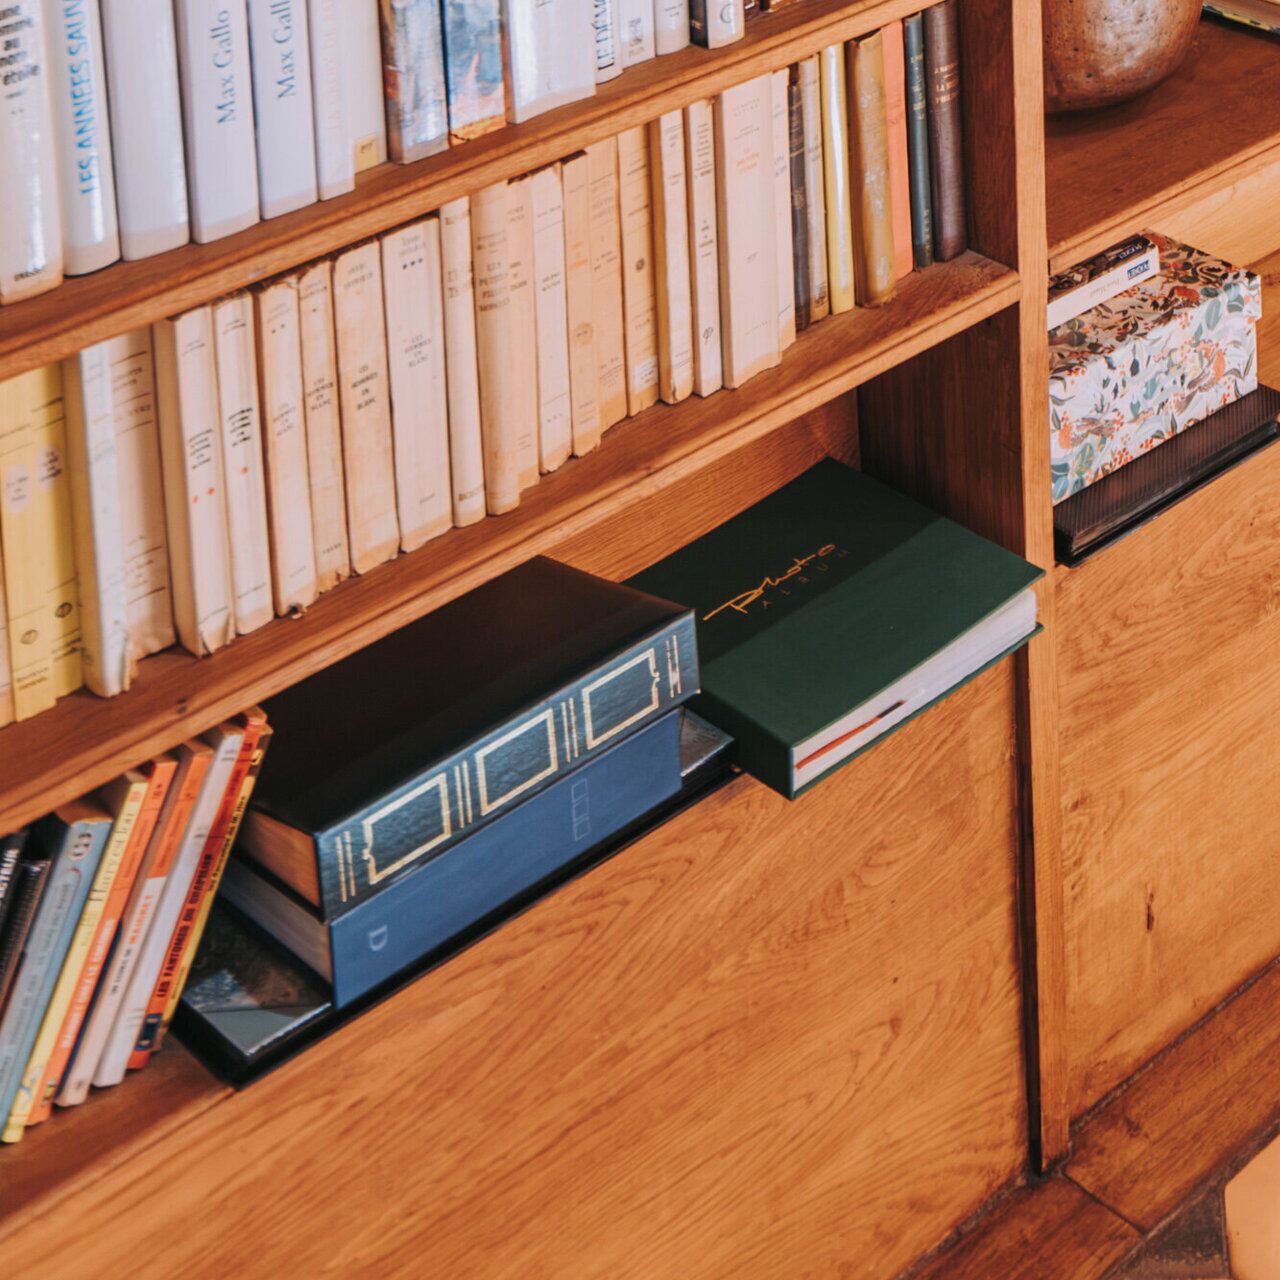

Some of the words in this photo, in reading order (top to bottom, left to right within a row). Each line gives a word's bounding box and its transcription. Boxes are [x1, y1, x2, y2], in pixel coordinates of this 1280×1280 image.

[207, 9, 234, 69] Gallo
[595, 47, 616, 72] LE
[212, 74, 237, 125] Max
[272, 49, 299, 99] Max
[77, 150, 96, 195] LES
[126, 892, 155, 946] MAIGRET
[155, 978, 171, 999] LES
[181, 905, 196, 923] DU
